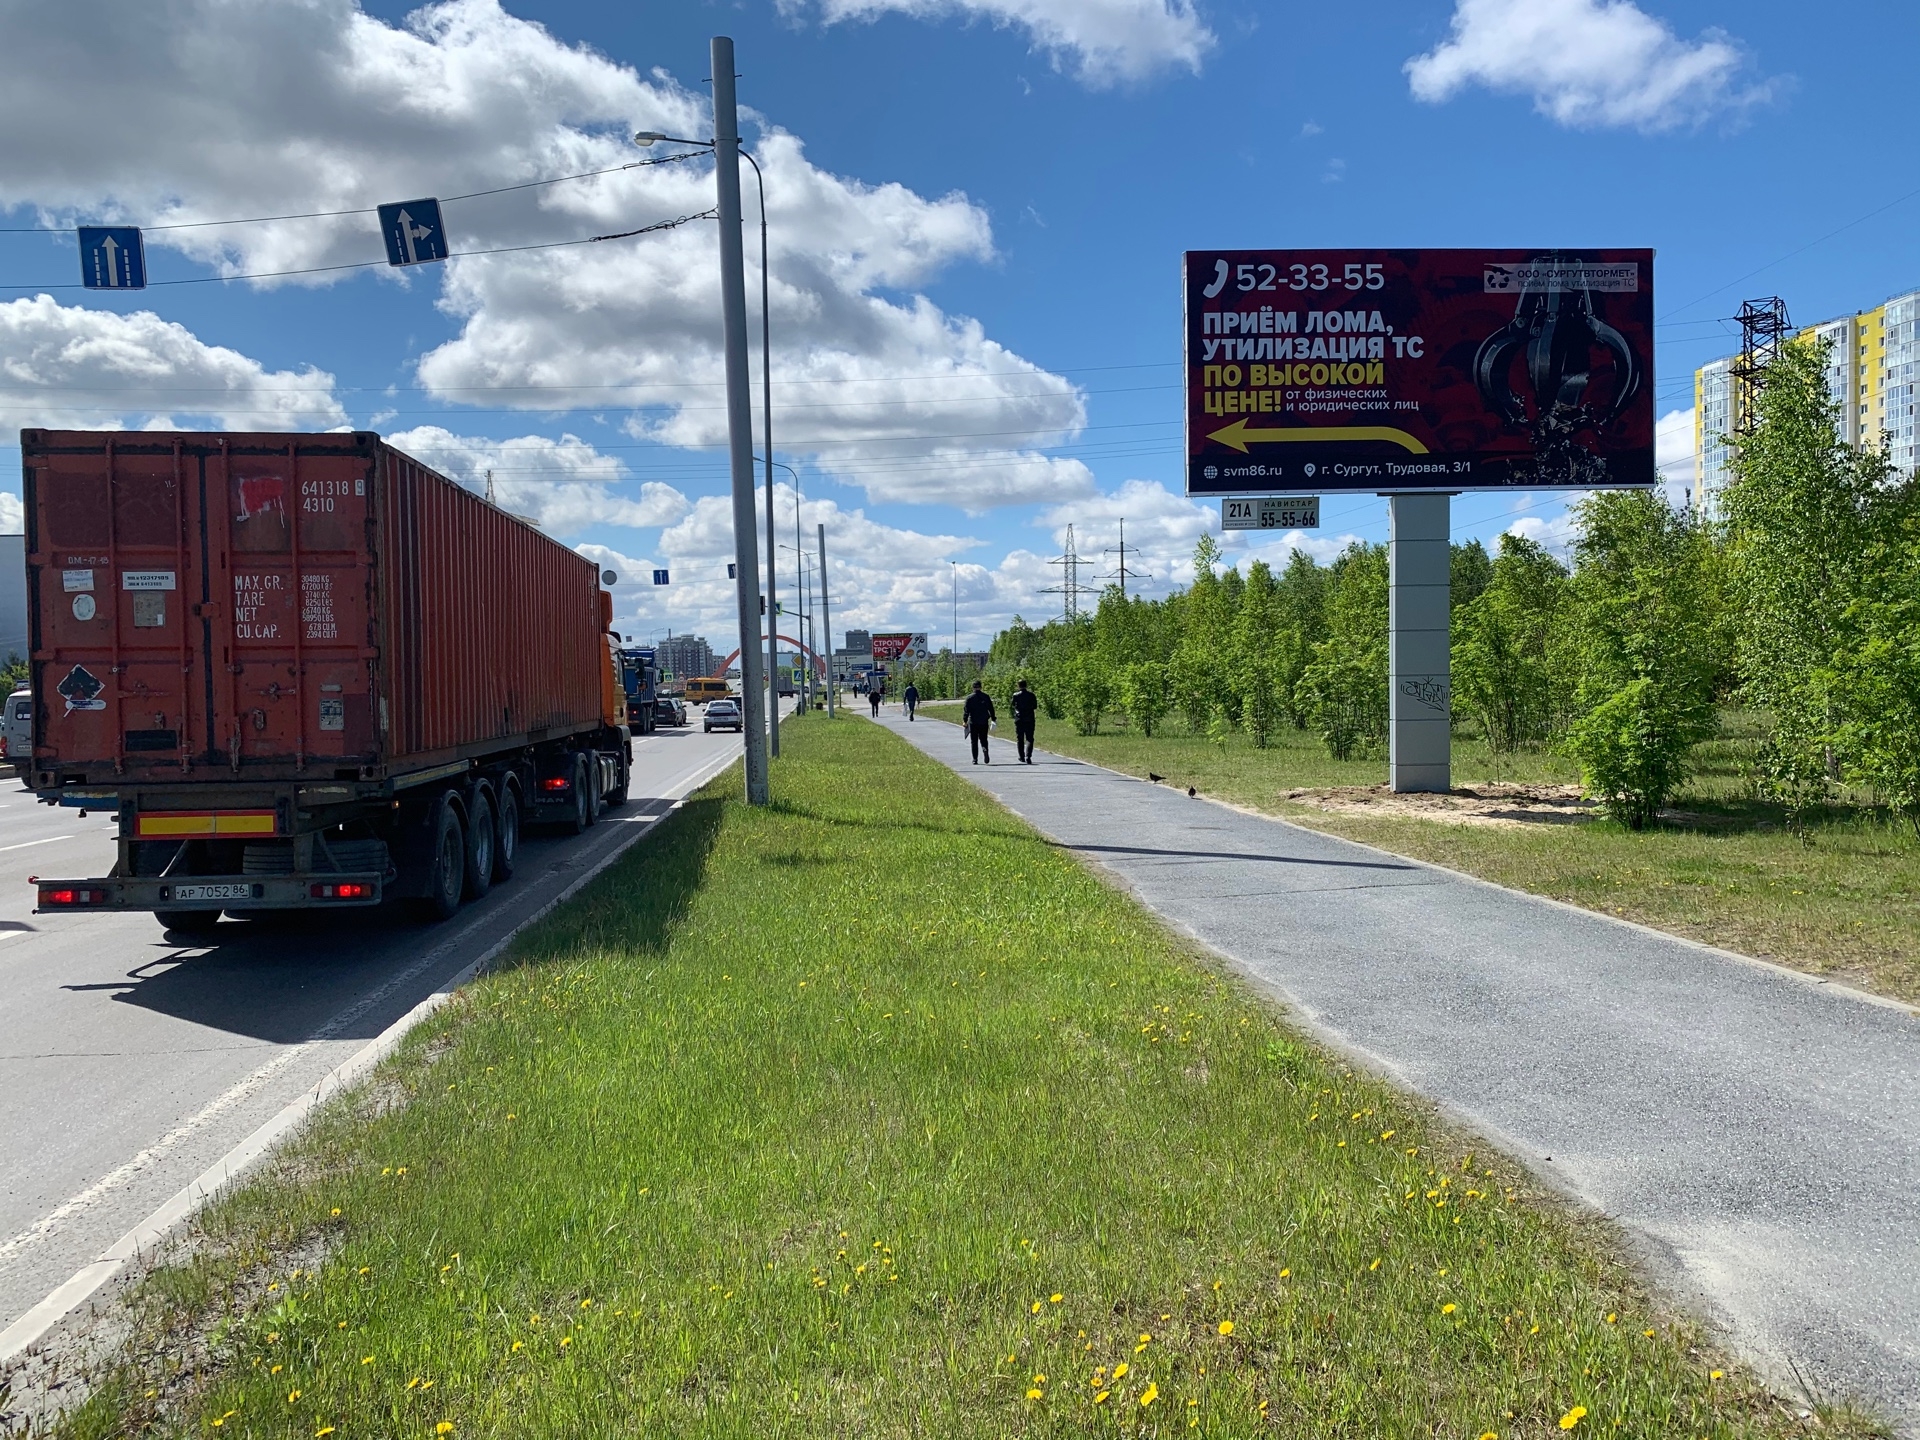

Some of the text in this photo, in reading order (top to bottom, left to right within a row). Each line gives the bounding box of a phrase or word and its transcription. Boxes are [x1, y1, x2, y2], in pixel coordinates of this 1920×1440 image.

[1236, 263, 1385, 291] 52-33-55
[1517, 269, 1540, 278] ООО
[1623, 278, 1635, 287] ТС
[1203, 305, 1395, 337] ПРИЁМ ЛОМА,
[1202, 336, 1425, 363] УТИЛИЗАЦИЯ ТС
[1203, 357, 1385, 387] ПО ВЫСОКОЙ
[1285, 388, 1388, 402] от физических
[1204, 389, 1282, 417] ЦЕНЕ!
[1286, 400, 1420, 414] и юридических лиц
[1223, 464, 1283, 477] svm86.ru
[1321, 461, 1471, 478] г. Сургут, Трудовая, 3/1
[301, 480, 363, 496] 641318 9
[302, 497, 334, 512] 4310
[1229, 503, 1252, 518] 21А
[1264, 500, 1313, 508] НАВИСТАР
[1261, 510, 1316, 528] 55-55-66
[235, 591, 266, 606] TARE
[235, 607, 257, 622] NET
[322, 613, 334, 622] LBS
[236, 623, 281, 639] CU.CAP.
[198, 886, 230, 898] 7052
[232, 884, 245, 894] 86
